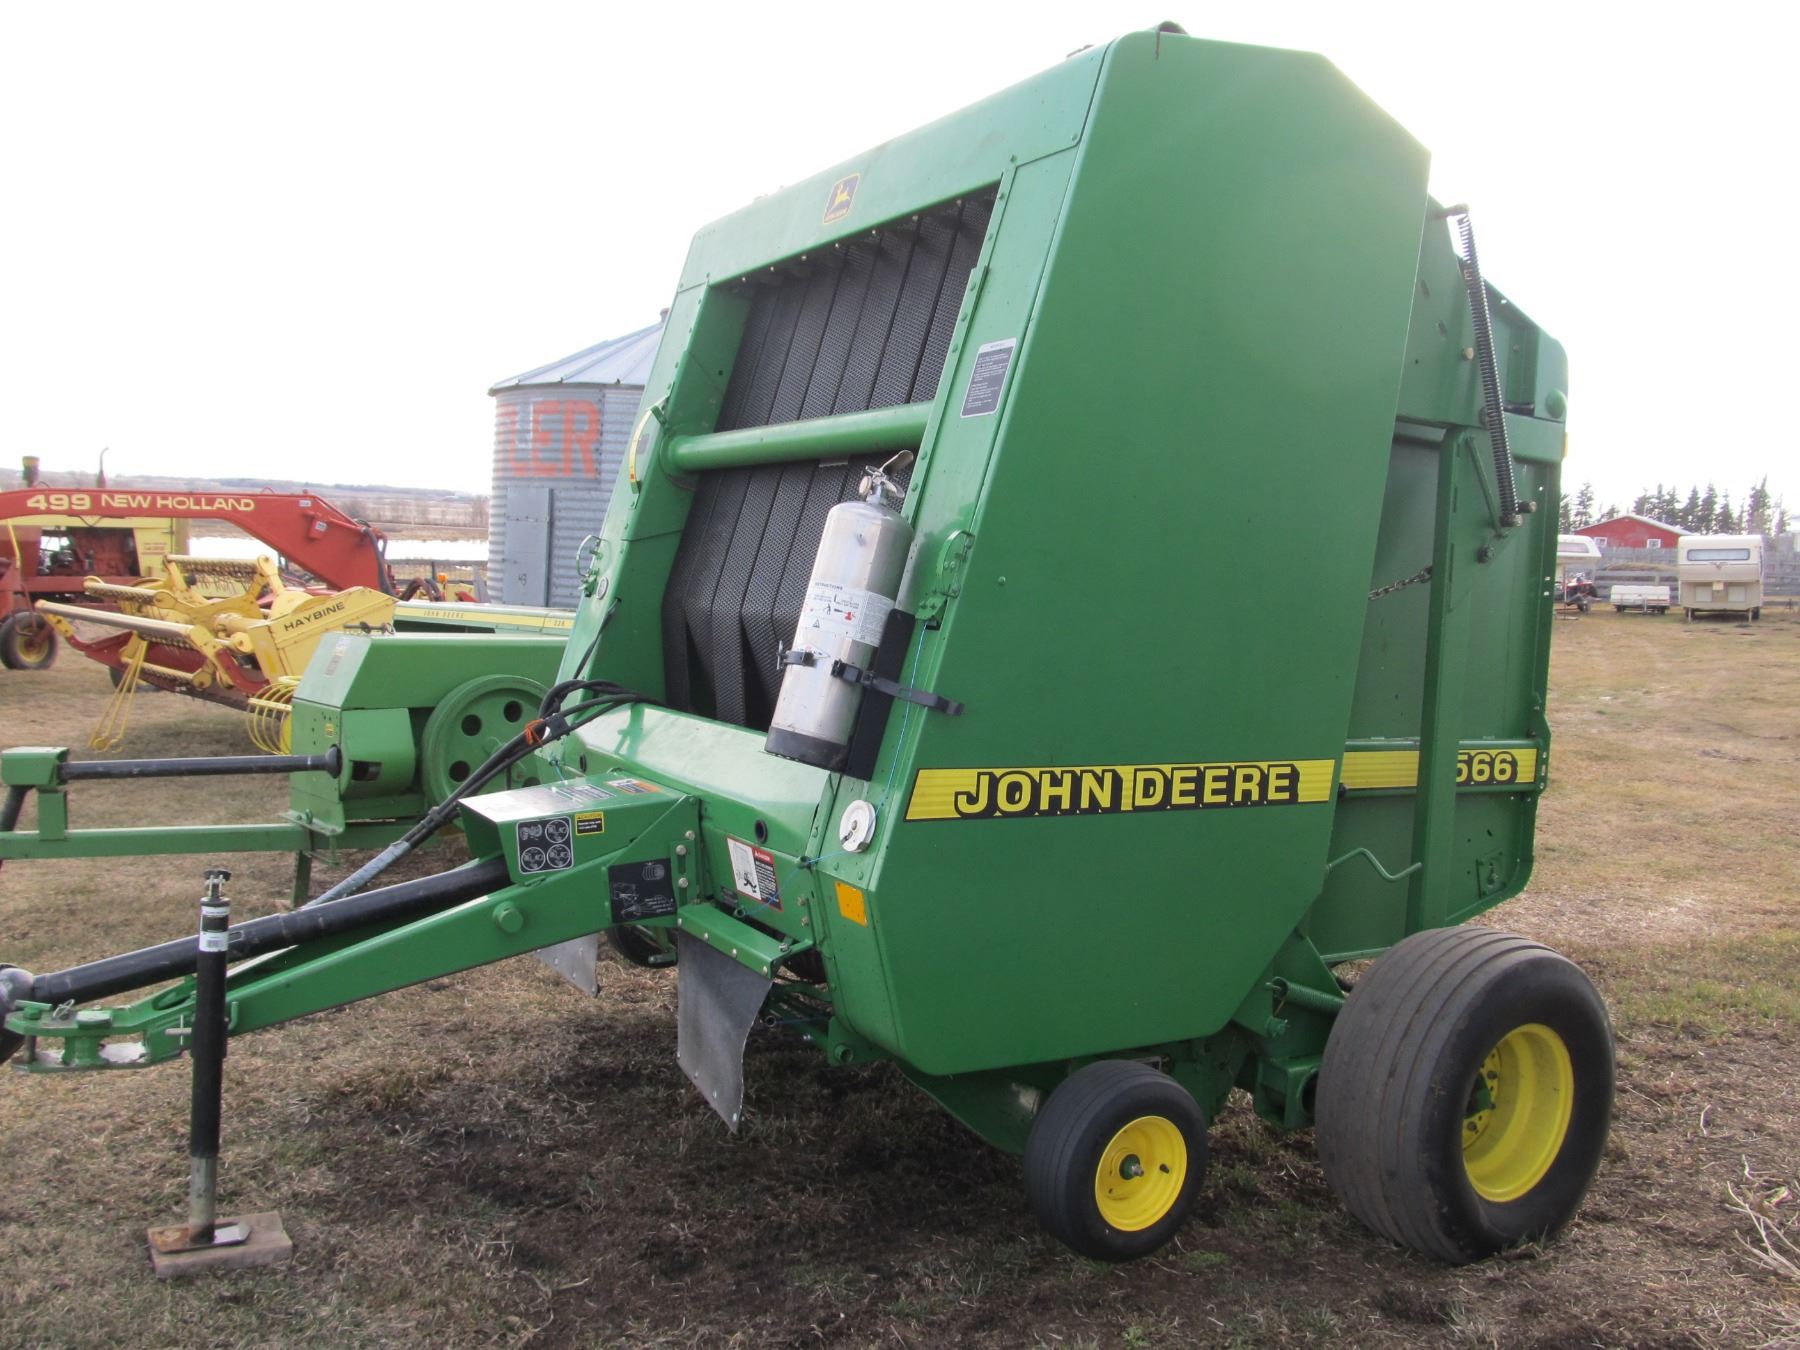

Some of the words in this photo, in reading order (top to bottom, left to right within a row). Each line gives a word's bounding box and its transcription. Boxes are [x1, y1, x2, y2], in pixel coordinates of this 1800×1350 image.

[26, 493, 91, 511] 499
[101, 493, 151, 508] NEW
[156, 495, 256, 512] HOLLAND
[283, 601, 345, 632] HAYBINE
[1456, 751, 1517, 784] 566
[954, 768, 1123, 819] JOHN
[1133, 763, 1300, 811] DEERE
